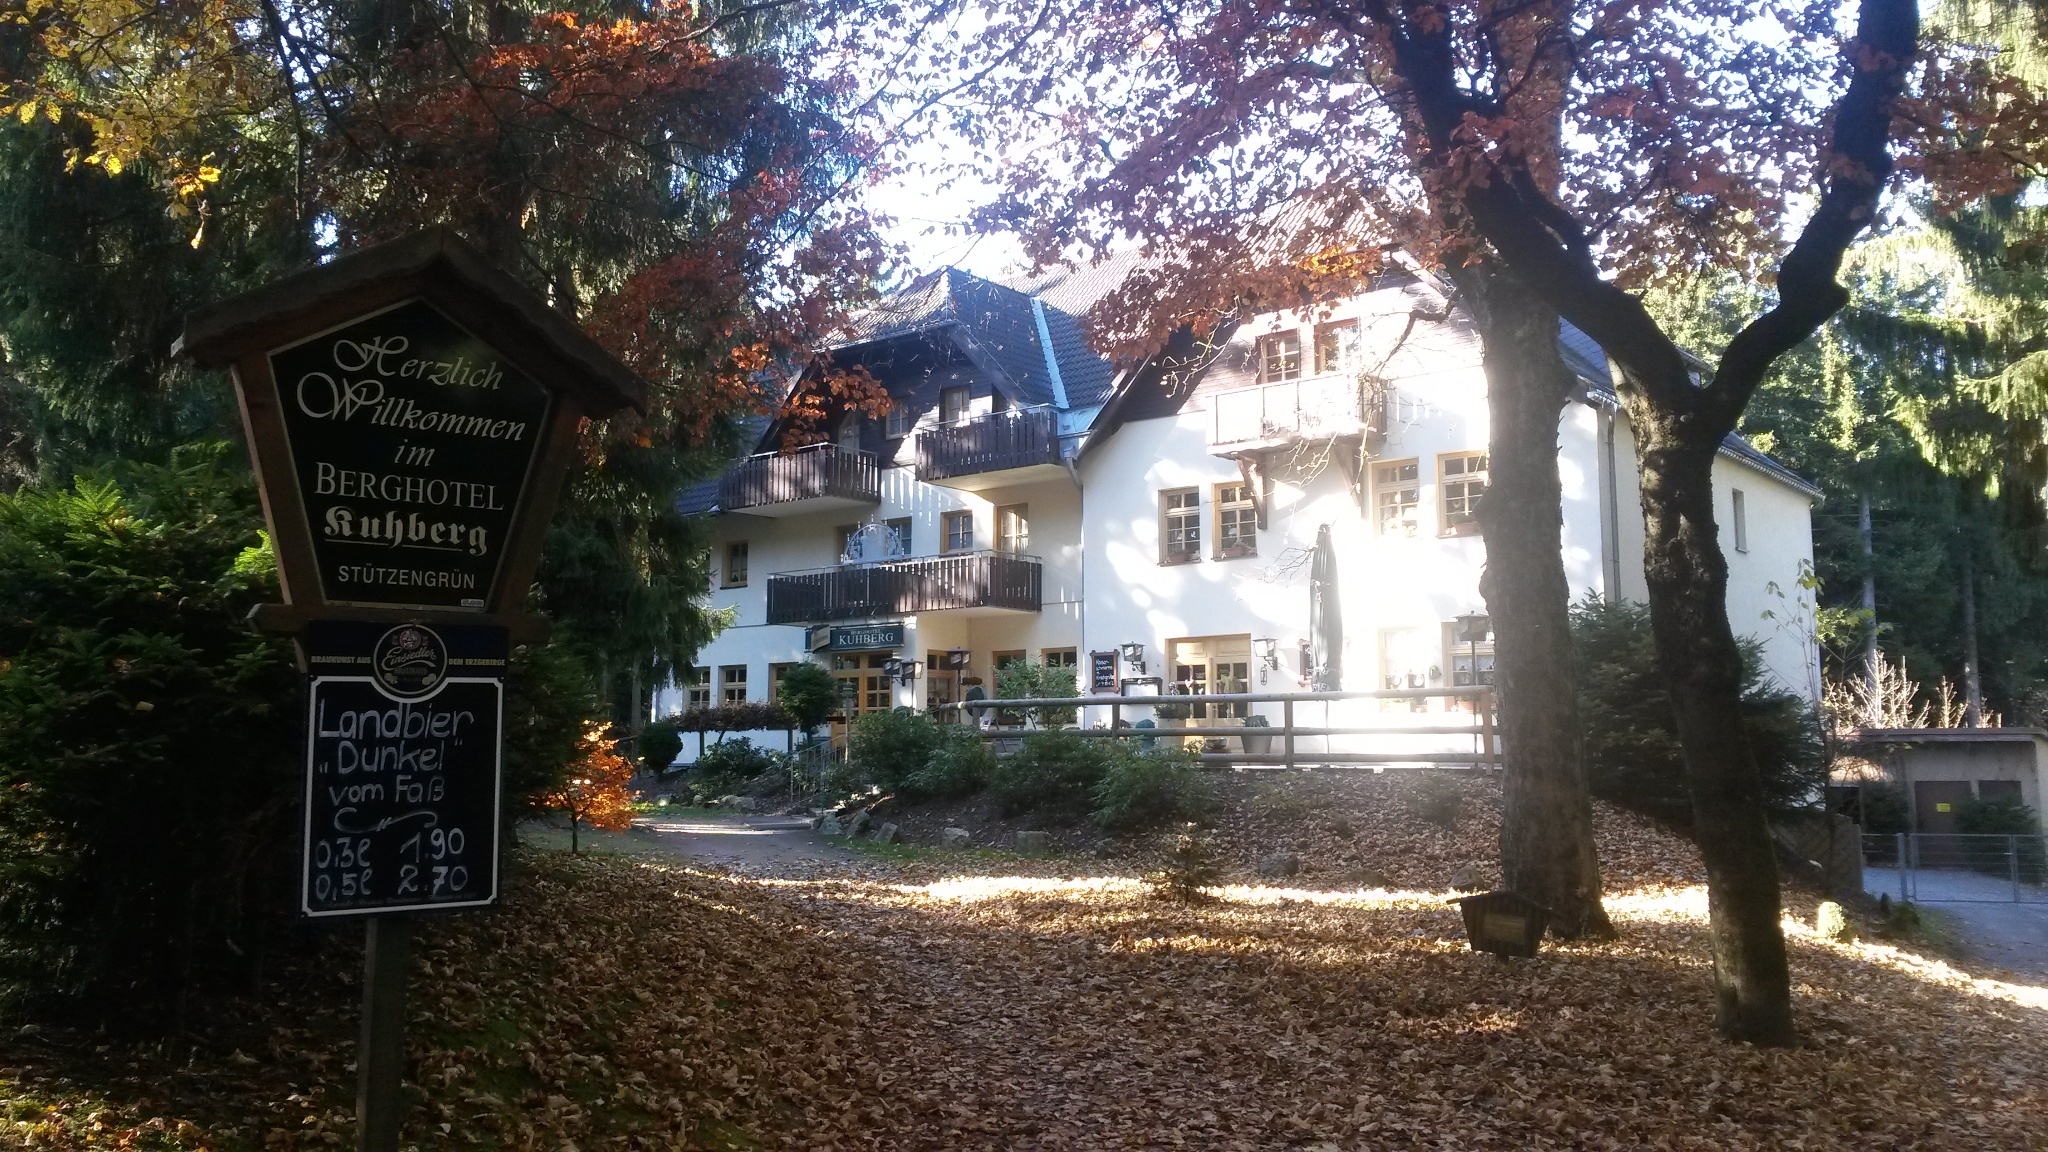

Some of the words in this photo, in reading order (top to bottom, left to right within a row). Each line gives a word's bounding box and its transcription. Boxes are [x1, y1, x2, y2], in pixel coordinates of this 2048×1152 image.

[333, 335, 503, 390] Herzlich
[296, 371, 526, 441] Willkommen
[394, 438, 436, 467] im
[314, 461, 504, 511] BERGHOTEL
[324, 505, 488, 556] Kuhberg
[338, 562, 475, 589] STÜTZENGRÜN
[839, 632, 894, 645] KUHBERG
[311, 655, 355, 664] BRAUKUNST
[356, 656, 372, 664] AUS
[381, 646, 437, 671] Einsiedler
[448, 658, 463, 666] DEM
[465, 658, 506, 667] ERZGEBIRGE
[318, 698, 475, 740] Landbier
[328, 783, 384, 806] vom
[395, 775, 445, 803] Faß
